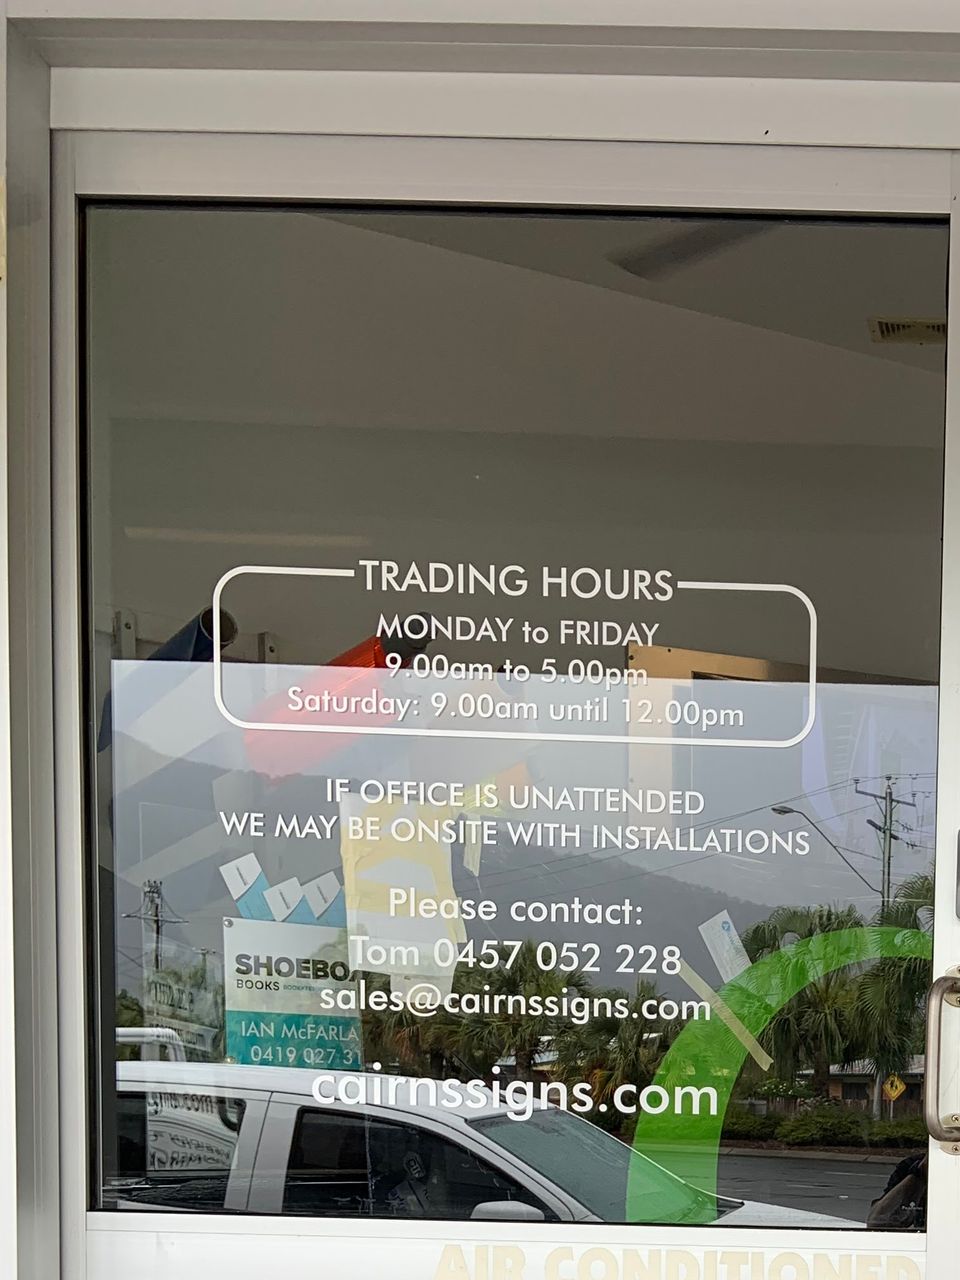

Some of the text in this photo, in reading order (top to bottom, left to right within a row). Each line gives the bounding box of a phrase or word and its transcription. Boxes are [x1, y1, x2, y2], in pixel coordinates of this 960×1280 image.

[358, 559, 674, 601] TRADING HOURS
[376, 614, 660, 649] MONDAY to FRIDAY
[385, 652, 649, 694] 9.00am to 5.00pm
[287, 687, 745, 733] Saturday: 9.00am until 12.00pm
[325, 778, 705, 815] IF OFFICE IS UNATTENDED
[219, 811, 811, 857] WE MAY BE ONSITE WITH INSTALLATIONS
[389, 887, 643, 926] Please contact:
[349, 934, 682, 975] Tom 0457 052 228
[237, 979, 280, 991] BOOKS
[319, 980, 712, 1024] sales@cairnssigns.com
[241, 1020, 275, 1038] IAN
[250, 1045, 296, 1063] 0419
[303, 1047, 337, 1064] 027
[311, 1062, 719, 1121] cairnssigns.com
